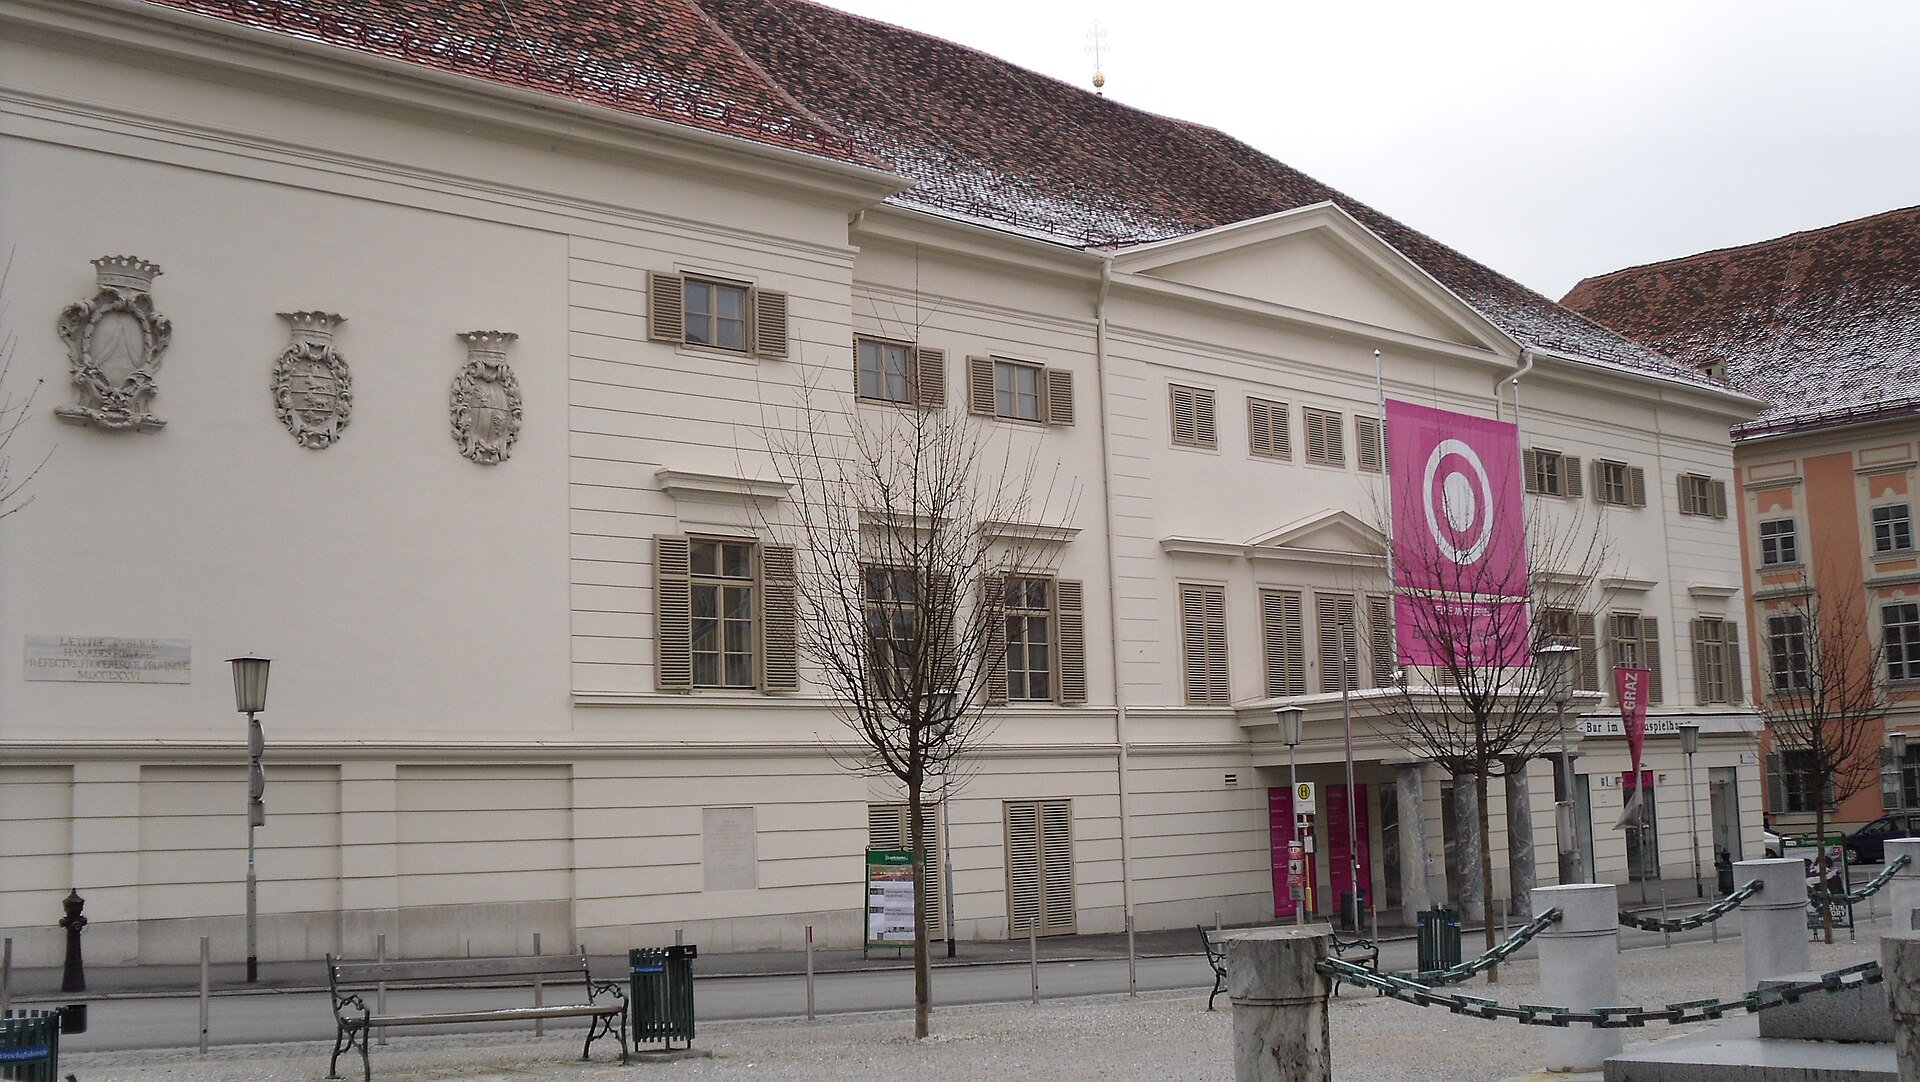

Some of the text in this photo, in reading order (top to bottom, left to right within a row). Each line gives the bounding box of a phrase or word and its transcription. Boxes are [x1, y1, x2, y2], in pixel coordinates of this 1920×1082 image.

[1623, 672, 1638, 710] GRAZ
[1586, 722, 1602, 733] Bar
[1607, 721, 1618, 732] im
[1300, 787, 1307, 797] H
